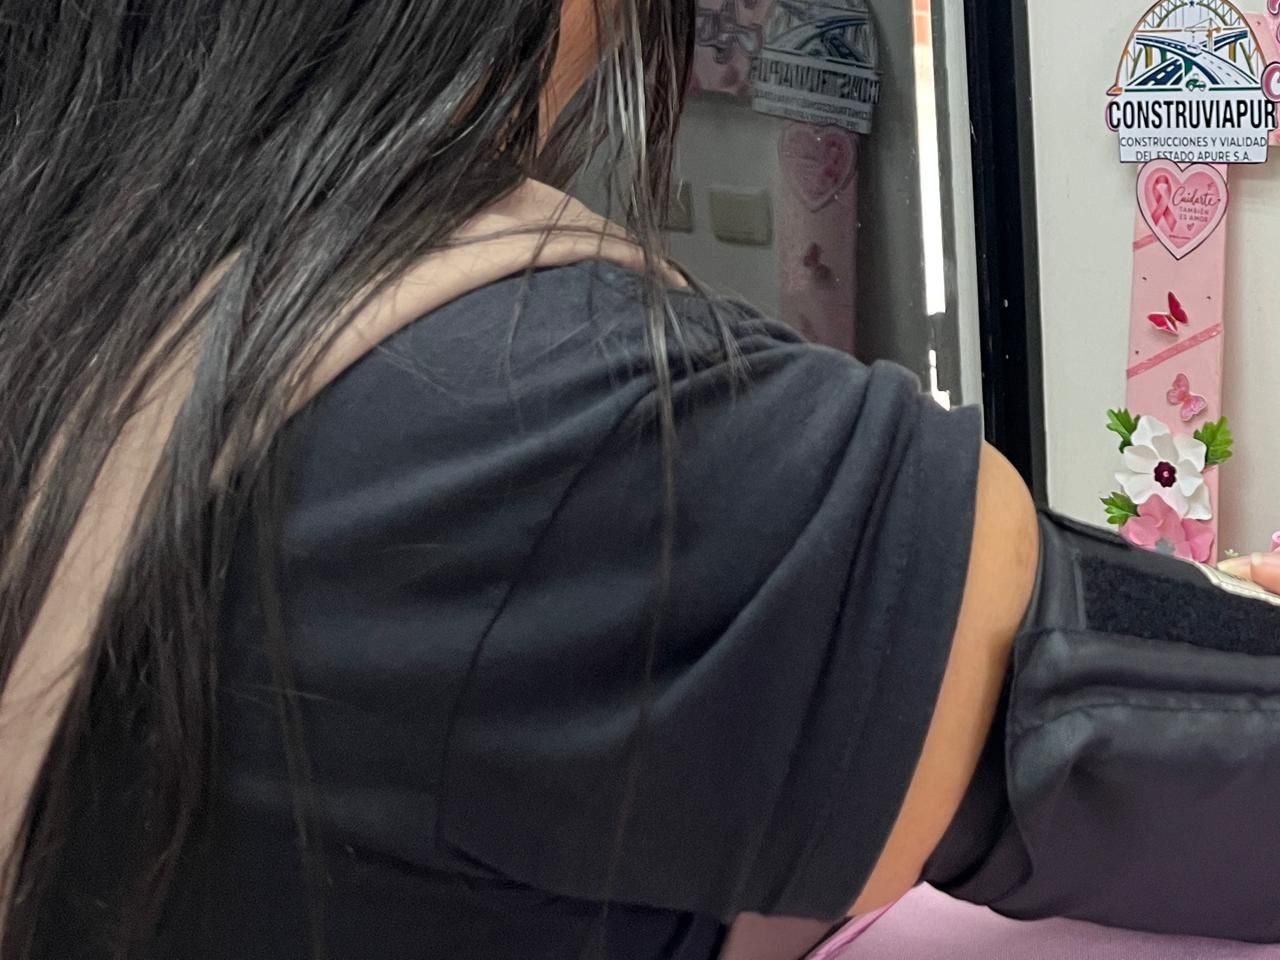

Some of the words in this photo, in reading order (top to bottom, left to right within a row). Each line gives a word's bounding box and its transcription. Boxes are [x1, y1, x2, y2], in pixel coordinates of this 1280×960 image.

[1108, 99, 1277, 129] CONSTRUVIAPUR
[1120, 136, 1209, 148] CONSTRUCCIONES
[1220, 136, 1267, 148] VIALIDAD
[1136, 151, 1154, 161] DEL
[1197, 151, 1231, 162] APURE
[1171, 185, 1218, 207] Cuidarte
